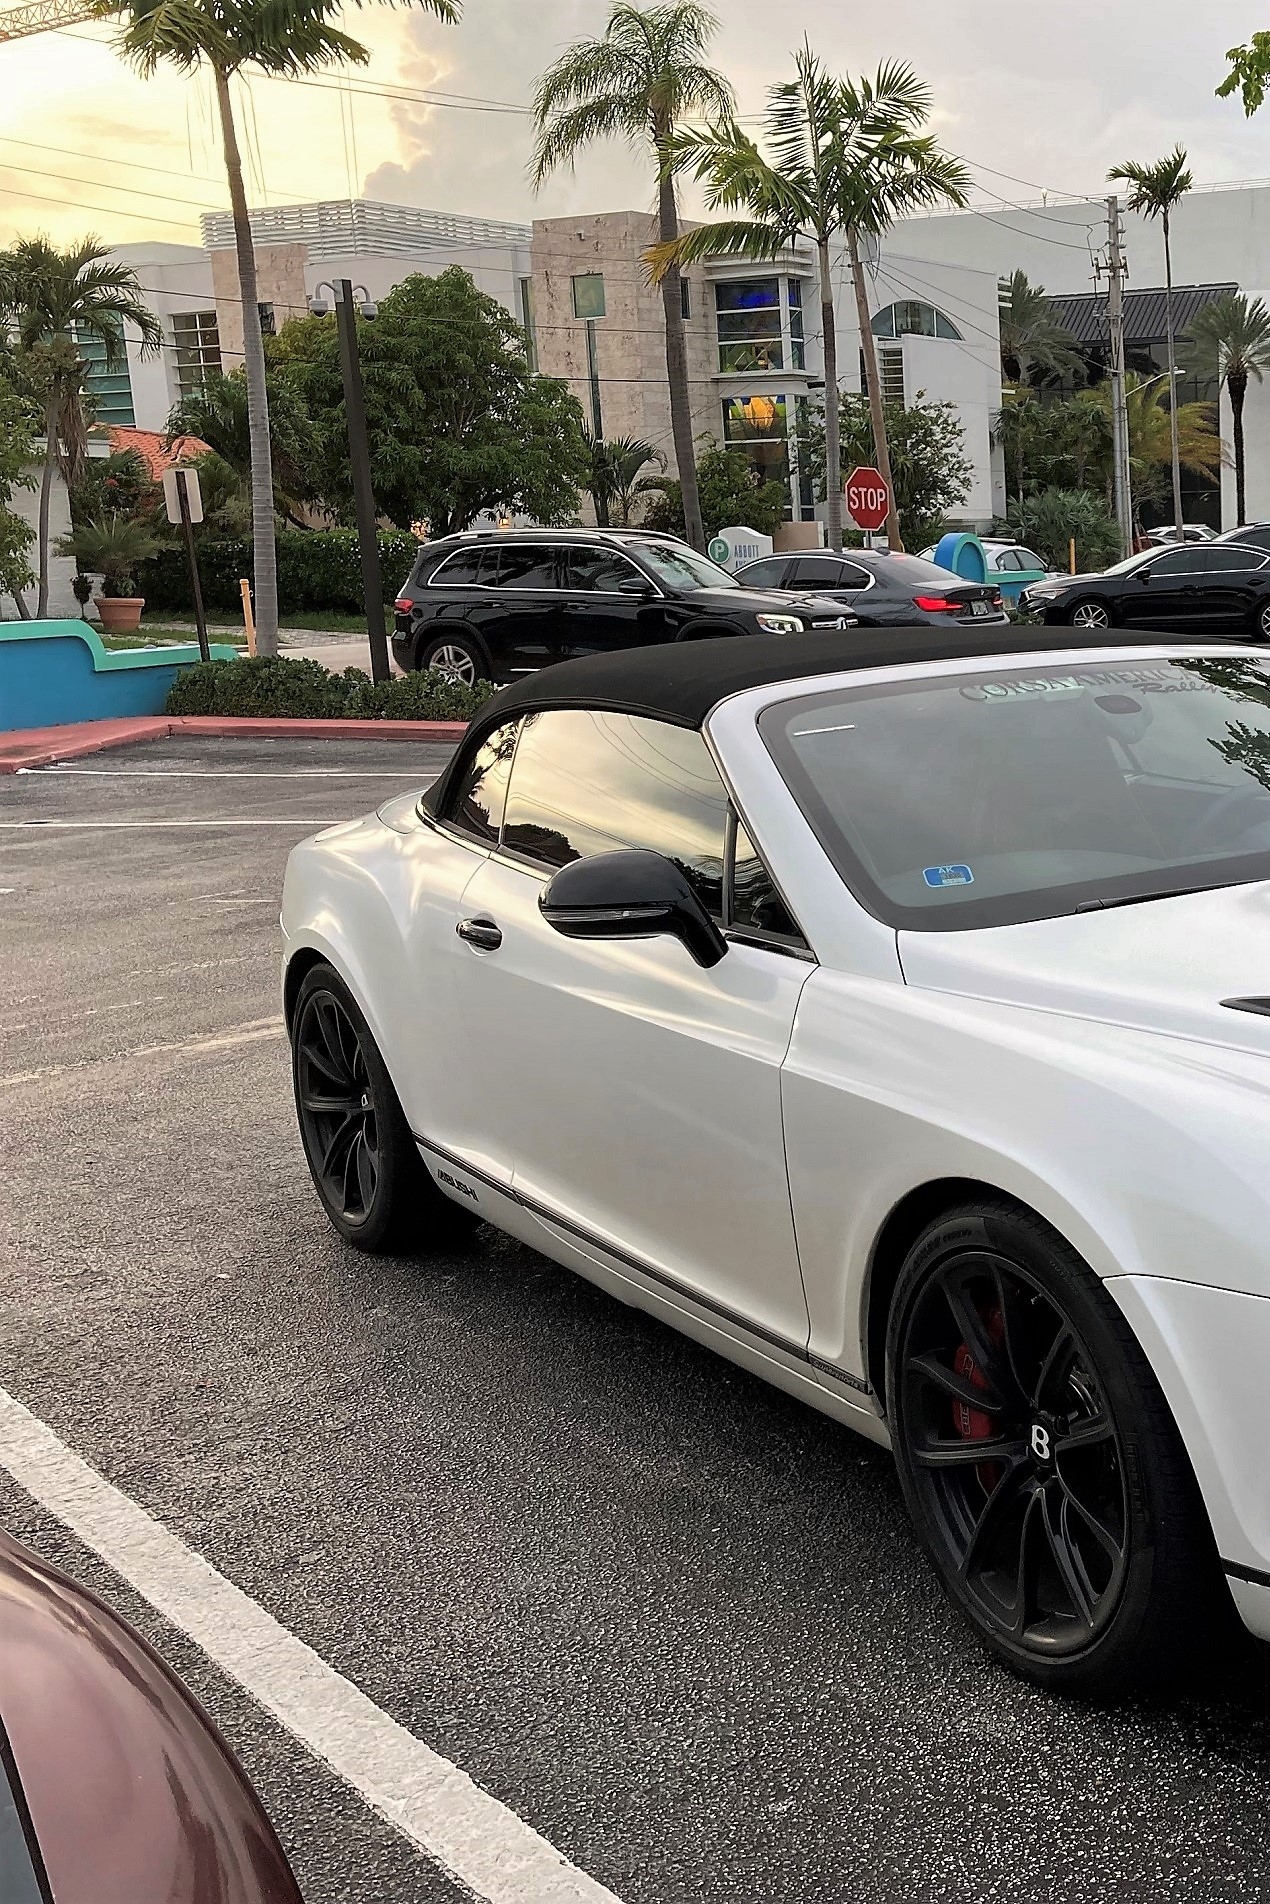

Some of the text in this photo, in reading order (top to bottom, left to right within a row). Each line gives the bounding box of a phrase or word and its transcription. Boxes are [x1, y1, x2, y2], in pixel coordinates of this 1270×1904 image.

[850, 486, 886, 510] STOP
[734, 545, 759, 558] ABBOTT
[959, 678, 1071, 701] CORSA
[1031, 1424, 1050, 1459] B
